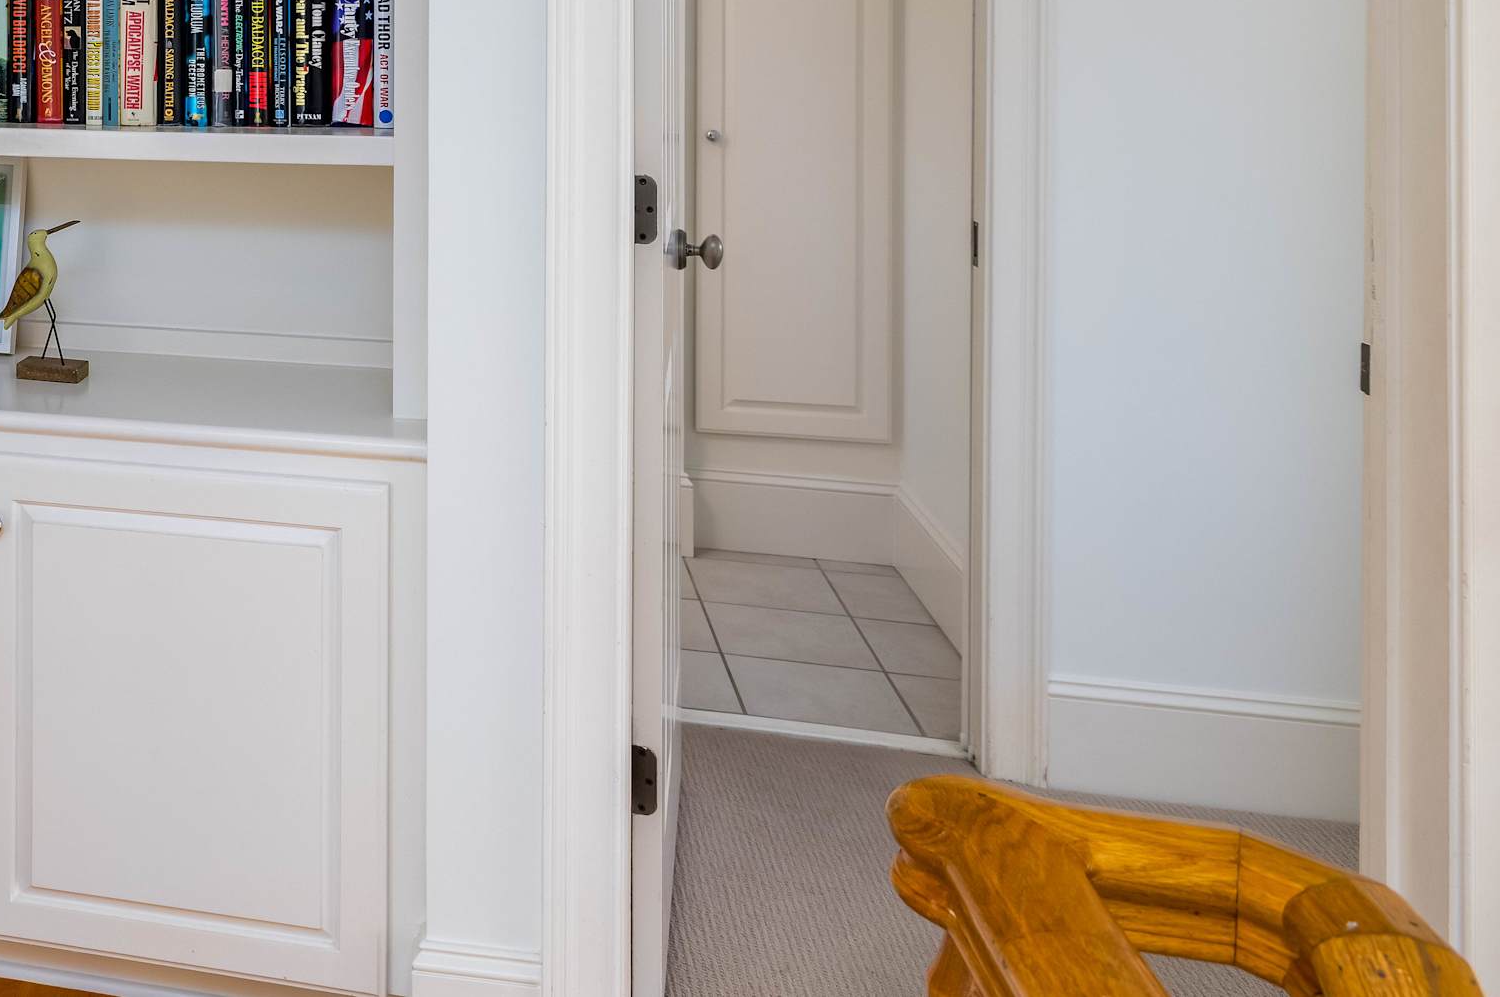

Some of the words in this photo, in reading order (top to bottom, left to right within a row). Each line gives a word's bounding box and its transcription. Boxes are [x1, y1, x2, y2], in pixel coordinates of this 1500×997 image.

[40, 4, 53, 48] ANGELS
[190, 3, 203, 34] LUDLUM
[275, 6, 284, 34] WARS
[295, 18, 309, 39] and
[311, 2, 326, 27] Tom
[12, 20, 28, 73] BALDACCI
[127, 11, 142, 72] APOCALYPSE
[235, 14, 244, 52] ELECTRONIC
[251, 16, 265, 69] BALDACCI
[378, 15, 391, 50] THOR
[165, 48, 175, 79] SAVING
[196, 47, 205, 60] THE
[220, 35, 229, 65] HENRY
[295, 42, 309, 63] The
[308, 29, 326, 69] Clancy
[380, 53, 389, 72] ACT
[40, 59, 53, 104] DEMONS
[71, 61, 80, 85] Darkest
[87, 68, 100, 77] OF
[87, 78, 100, 89] MY
[188, 59, 197, 98] DECEPTION
[196, 63, 205, 110] PROMETHEUS
[293, 66, 309, 106] Dragon
[380, 74, 389, 85] OF
[68, 86, 79, 112] Evening
[126, 74, 140, 110] WATCH
[165, 81, 175, 108] FAITH
[249, 71, 268, 111] MERCY
[380, 87, 389, 108] WAR
